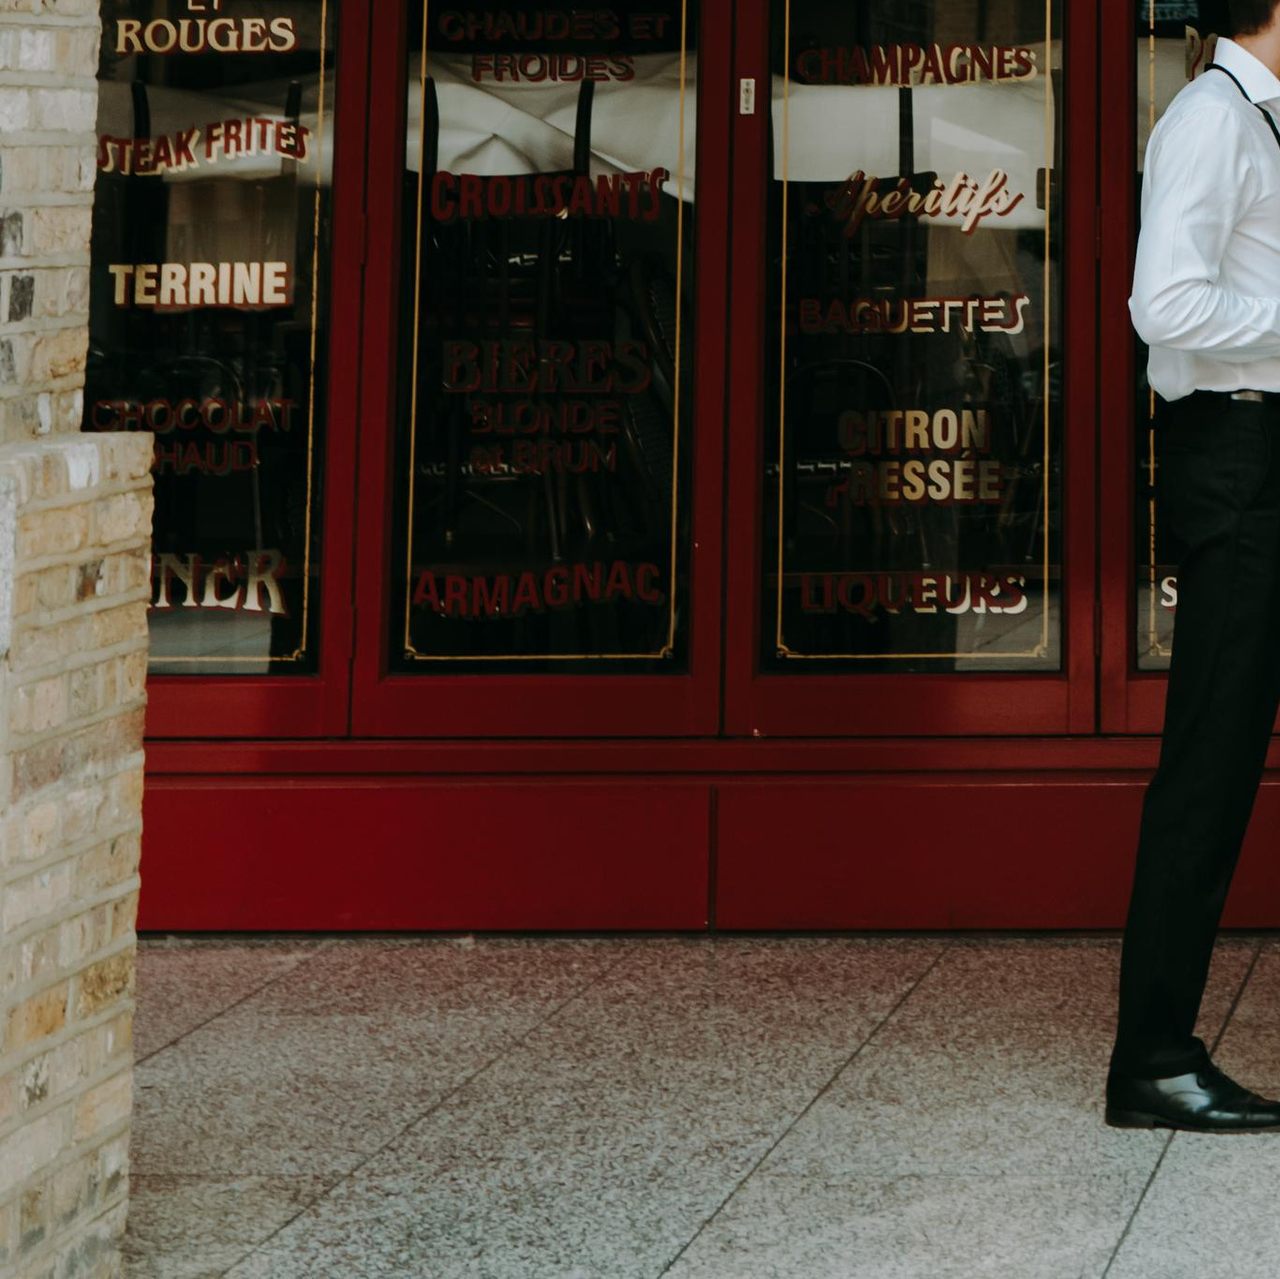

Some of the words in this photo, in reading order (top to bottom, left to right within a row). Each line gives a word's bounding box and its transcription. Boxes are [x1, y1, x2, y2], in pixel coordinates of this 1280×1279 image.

[115, 16, 299, 55] ROUGES
[471, 51, 637, 83] FROIDES
[794, 42, 1039, 89] CHAMPAGNES
[97, 124, 201, 176] STEAK
[204, 117, 314, 165] FRITES
[429, 166, 671, 223] CROISSANTS
[107, 261, 292, 310] TERRINE
[799, 294, 1031, 336] BAGUETTES
[90, 398, 298, 435] CHOCOLAT
[837, 408, 991, 456] CITRON
[151, 439, 261, 477] HAUD
[411, 559, 667, 620] ARMAGNAC
[800, 572, 1029, 623] LIQUEURS
